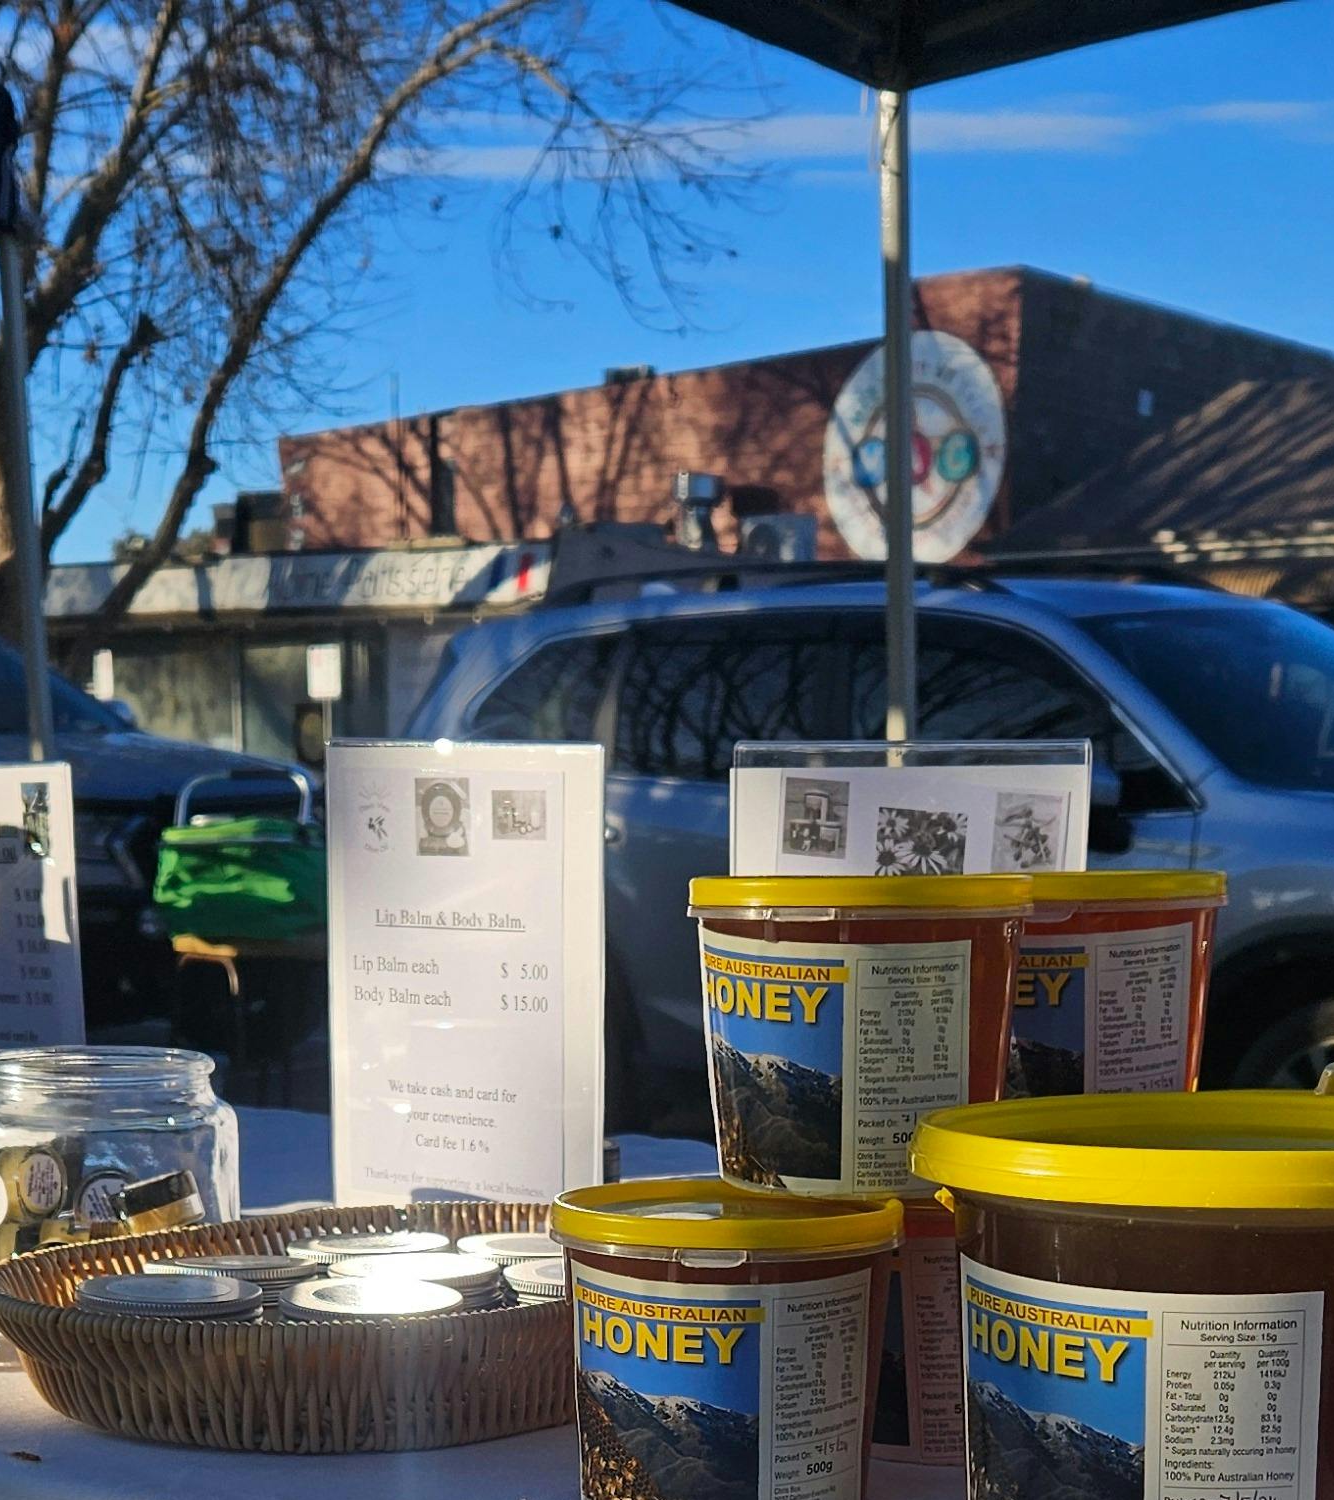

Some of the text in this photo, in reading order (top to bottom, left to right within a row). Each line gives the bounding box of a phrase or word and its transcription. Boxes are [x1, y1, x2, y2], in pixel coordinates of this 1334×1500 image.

[375, 909, 526, 929] Lip Balm & Body Balm.
[353, 955, 548, 980] Lip Balm each $ 5.00
[725, 960, 830, 981] AUSTRALIAN
[871, 963, 959, 975] Nutrition Information
[354, 985, 548, 1012] Body Balm each $ 15.00
[388, 1079, 517, 1104] We take cash and card for
[406, 1111, 498, 1128] your convenience.
[415, 1134, 440, 1148] Card
[442, 1136, 458, 1150] fee
[582, 1288, 746, 1322] PURE AUSTRALIAN
[971, 1288, 1131, 1334] PURE AUSTRALIAN
[1181, 1319, 1297, 1331] Nutrition Information
[583, 1307, 745, 1365] HONEY
[1200, 1333, 1234, 1343] Serving
[1261, 1333, 1277, 1342] 15g
[971, 1308, 1130, 1383] HONEY
[1210, 1349, 1289, 1360] Quantity Quantity
[1204, 1358, 1290, 1369] per serving per 100g
[1166, 1370, 1192, 1380] Energy
[1213, 1371, 1236, 1379] 212kJ
[1213, 1381, 1235, 1391] 0.05g
[1264, 1380, 1281, 1391] 0.3g
[1166, 1392, 1177, 1400] Fat
[1184, 1392, 1202, 1401] Total
[1219, 1393, 1229, 1402] 0g
[1267, 1392, 1277, 1402] 0g
[1171, 1403, 1206, 1412] Saturated
[1219, 1404, 1229, 1413] 0g
[1267, 1403, 1277, 1412] 0g
[1260, 1414, 1282, 1423] 83.1g
[1213, 1426, 1234, 1435] 12.4g
[1260, 1425, 1282, 1434] 82.5g
[1165, 1435, 1282, 1446] Sodium 2.3mg 15mg
[1171, 1446, 1197, 1456] Sugars
[1199, 1447, 1230, 1457] naturally
[806, 1460, 833, 1476] 500g
[1164, 1458, 1215, 1469] Ingredients:
[1165, 1471, 1295, 1482] 100% Pure Australian Honey
